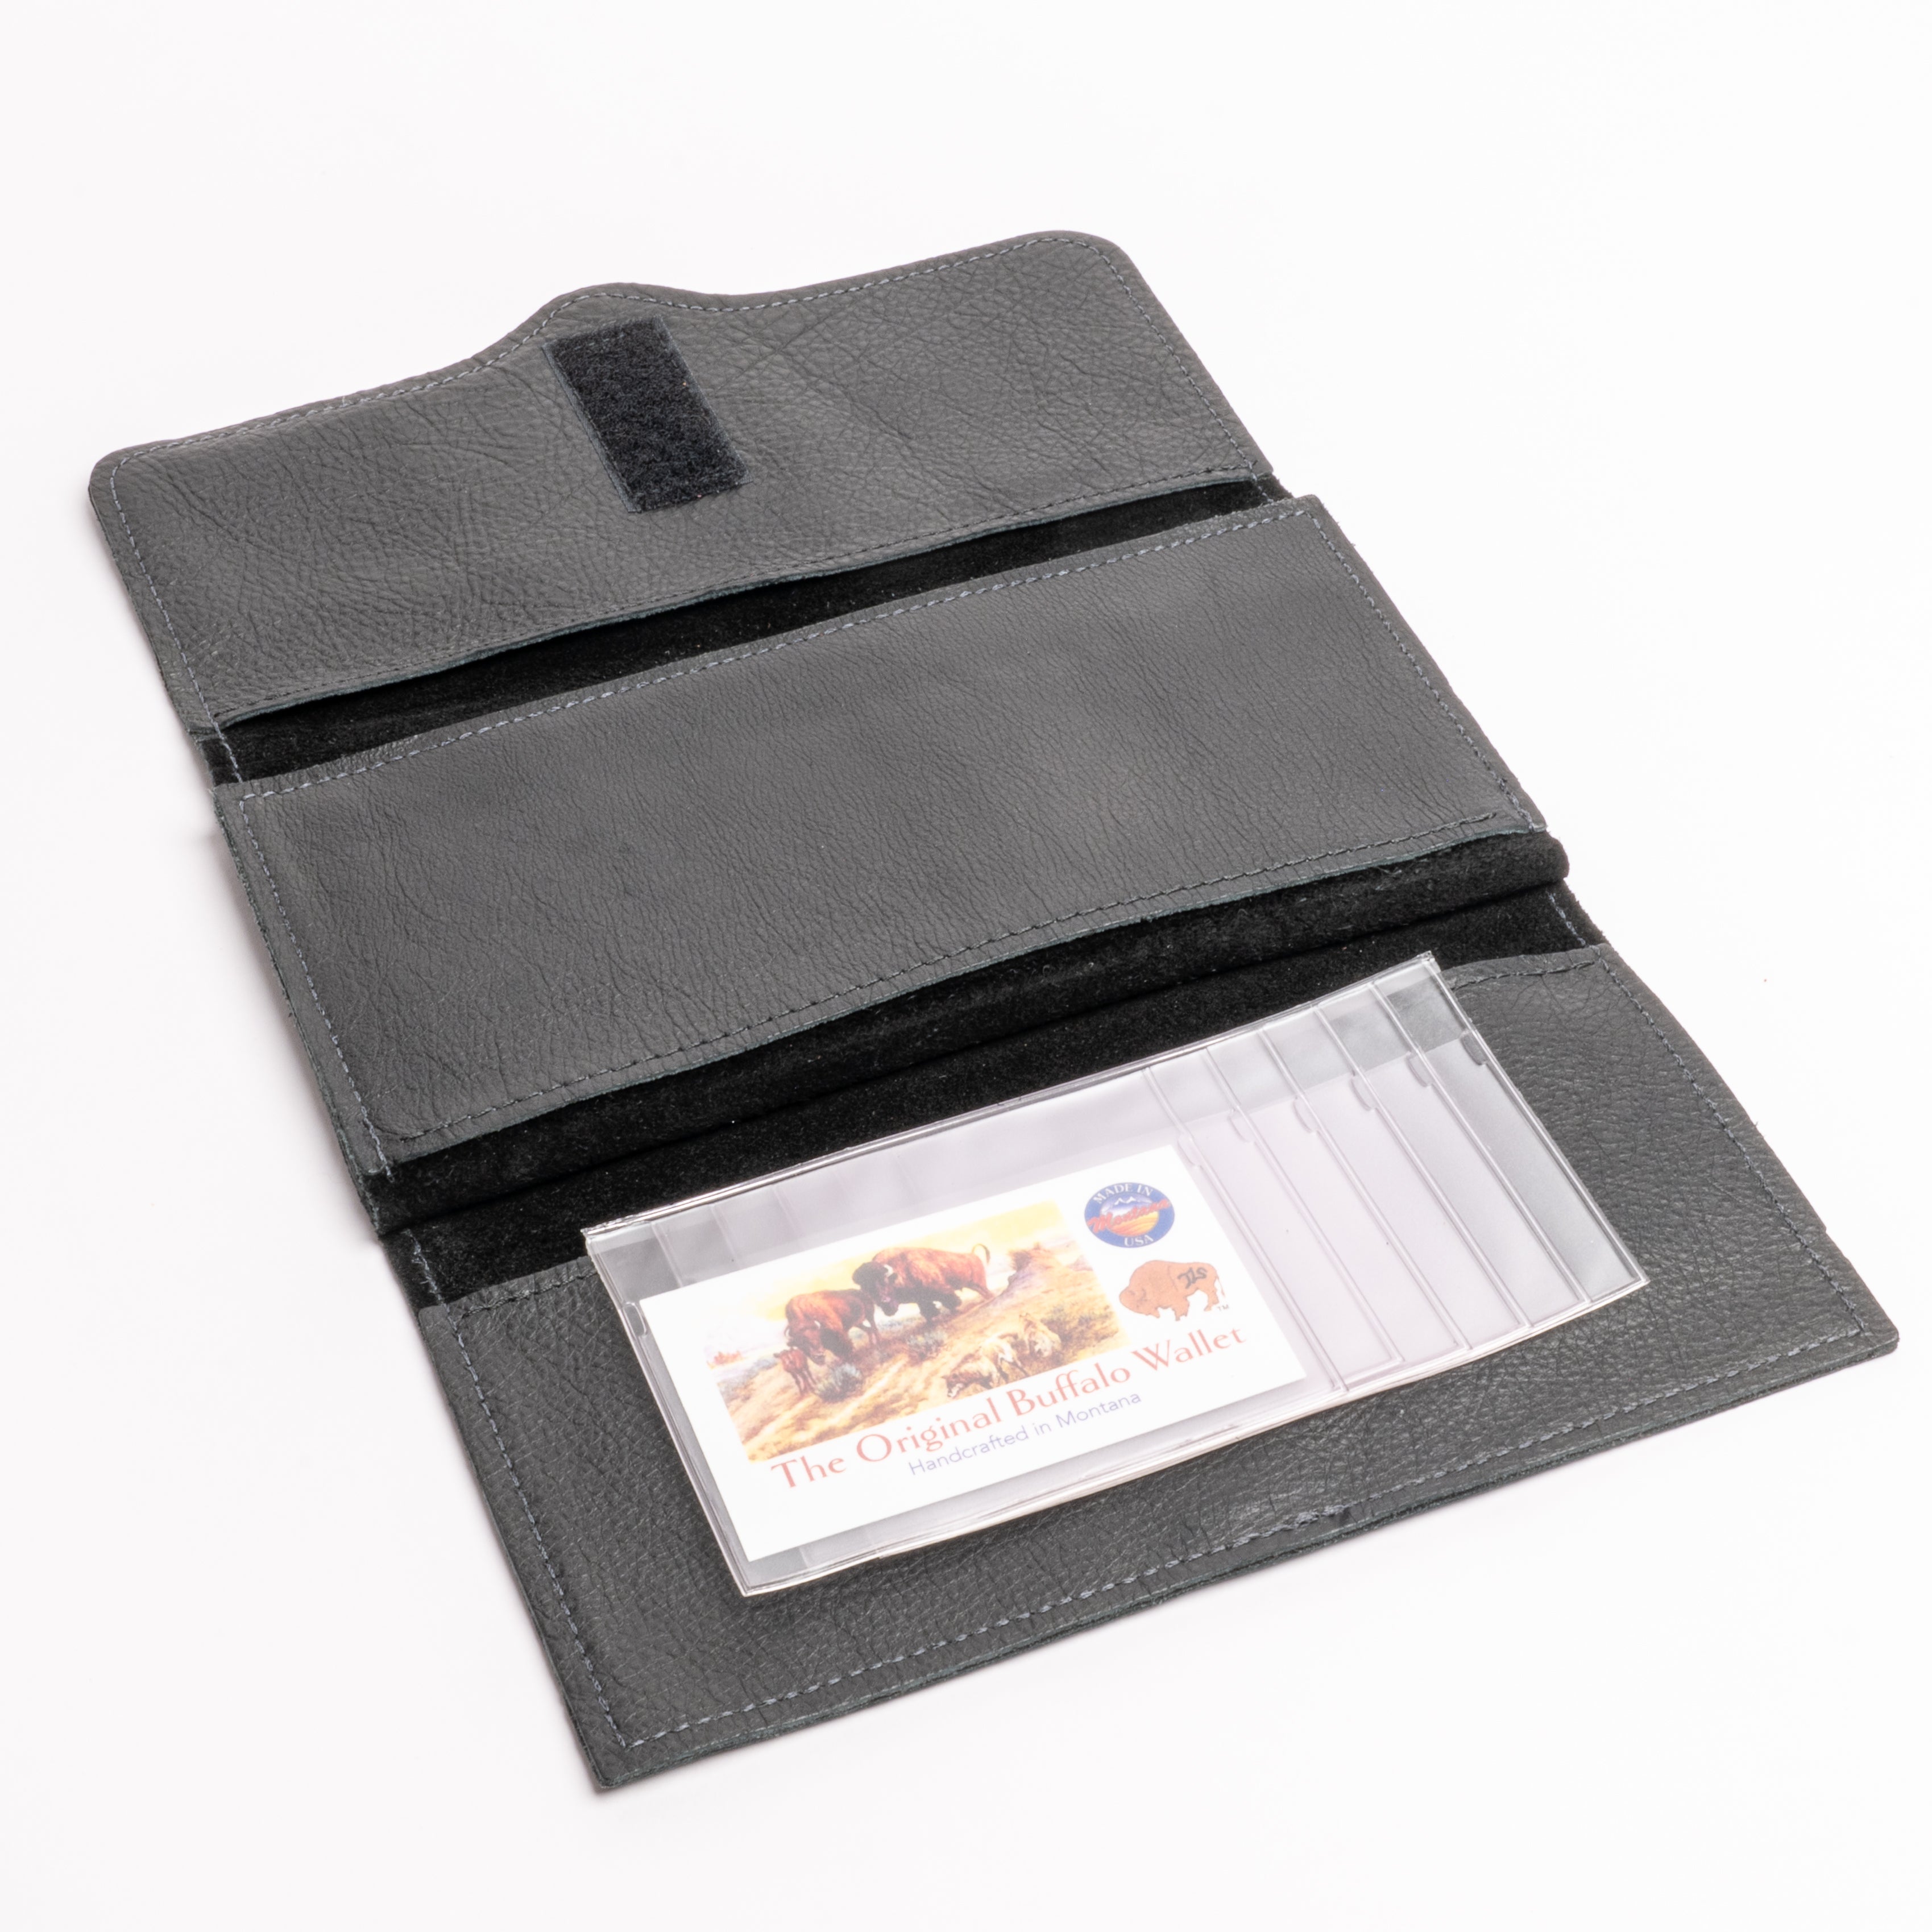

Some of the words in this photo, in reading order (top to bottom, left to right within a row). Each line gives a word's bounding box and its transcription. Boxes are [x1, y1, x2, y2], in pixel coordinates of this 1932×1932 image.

[1093, 1183, 1133, 1204] MADE
[1137, 1184, 1153, 1196] IN
[1087, 1199, 1170, 1233] Montana
[1124, 1234, 1154, 1247] USA
[771, 1455, 846, 1488] The
[856, 1397, 1002, 1462] Original
[1006, 1363, 1131, 1416] Buffalo
[1130, 1326, 1246, 1371] Wallet
[908, 1426, 1030, 1476] Handcrafted
[1033, 1421, 1052, 1436] in
[1055, 1392, 1142, 1428] Montana
